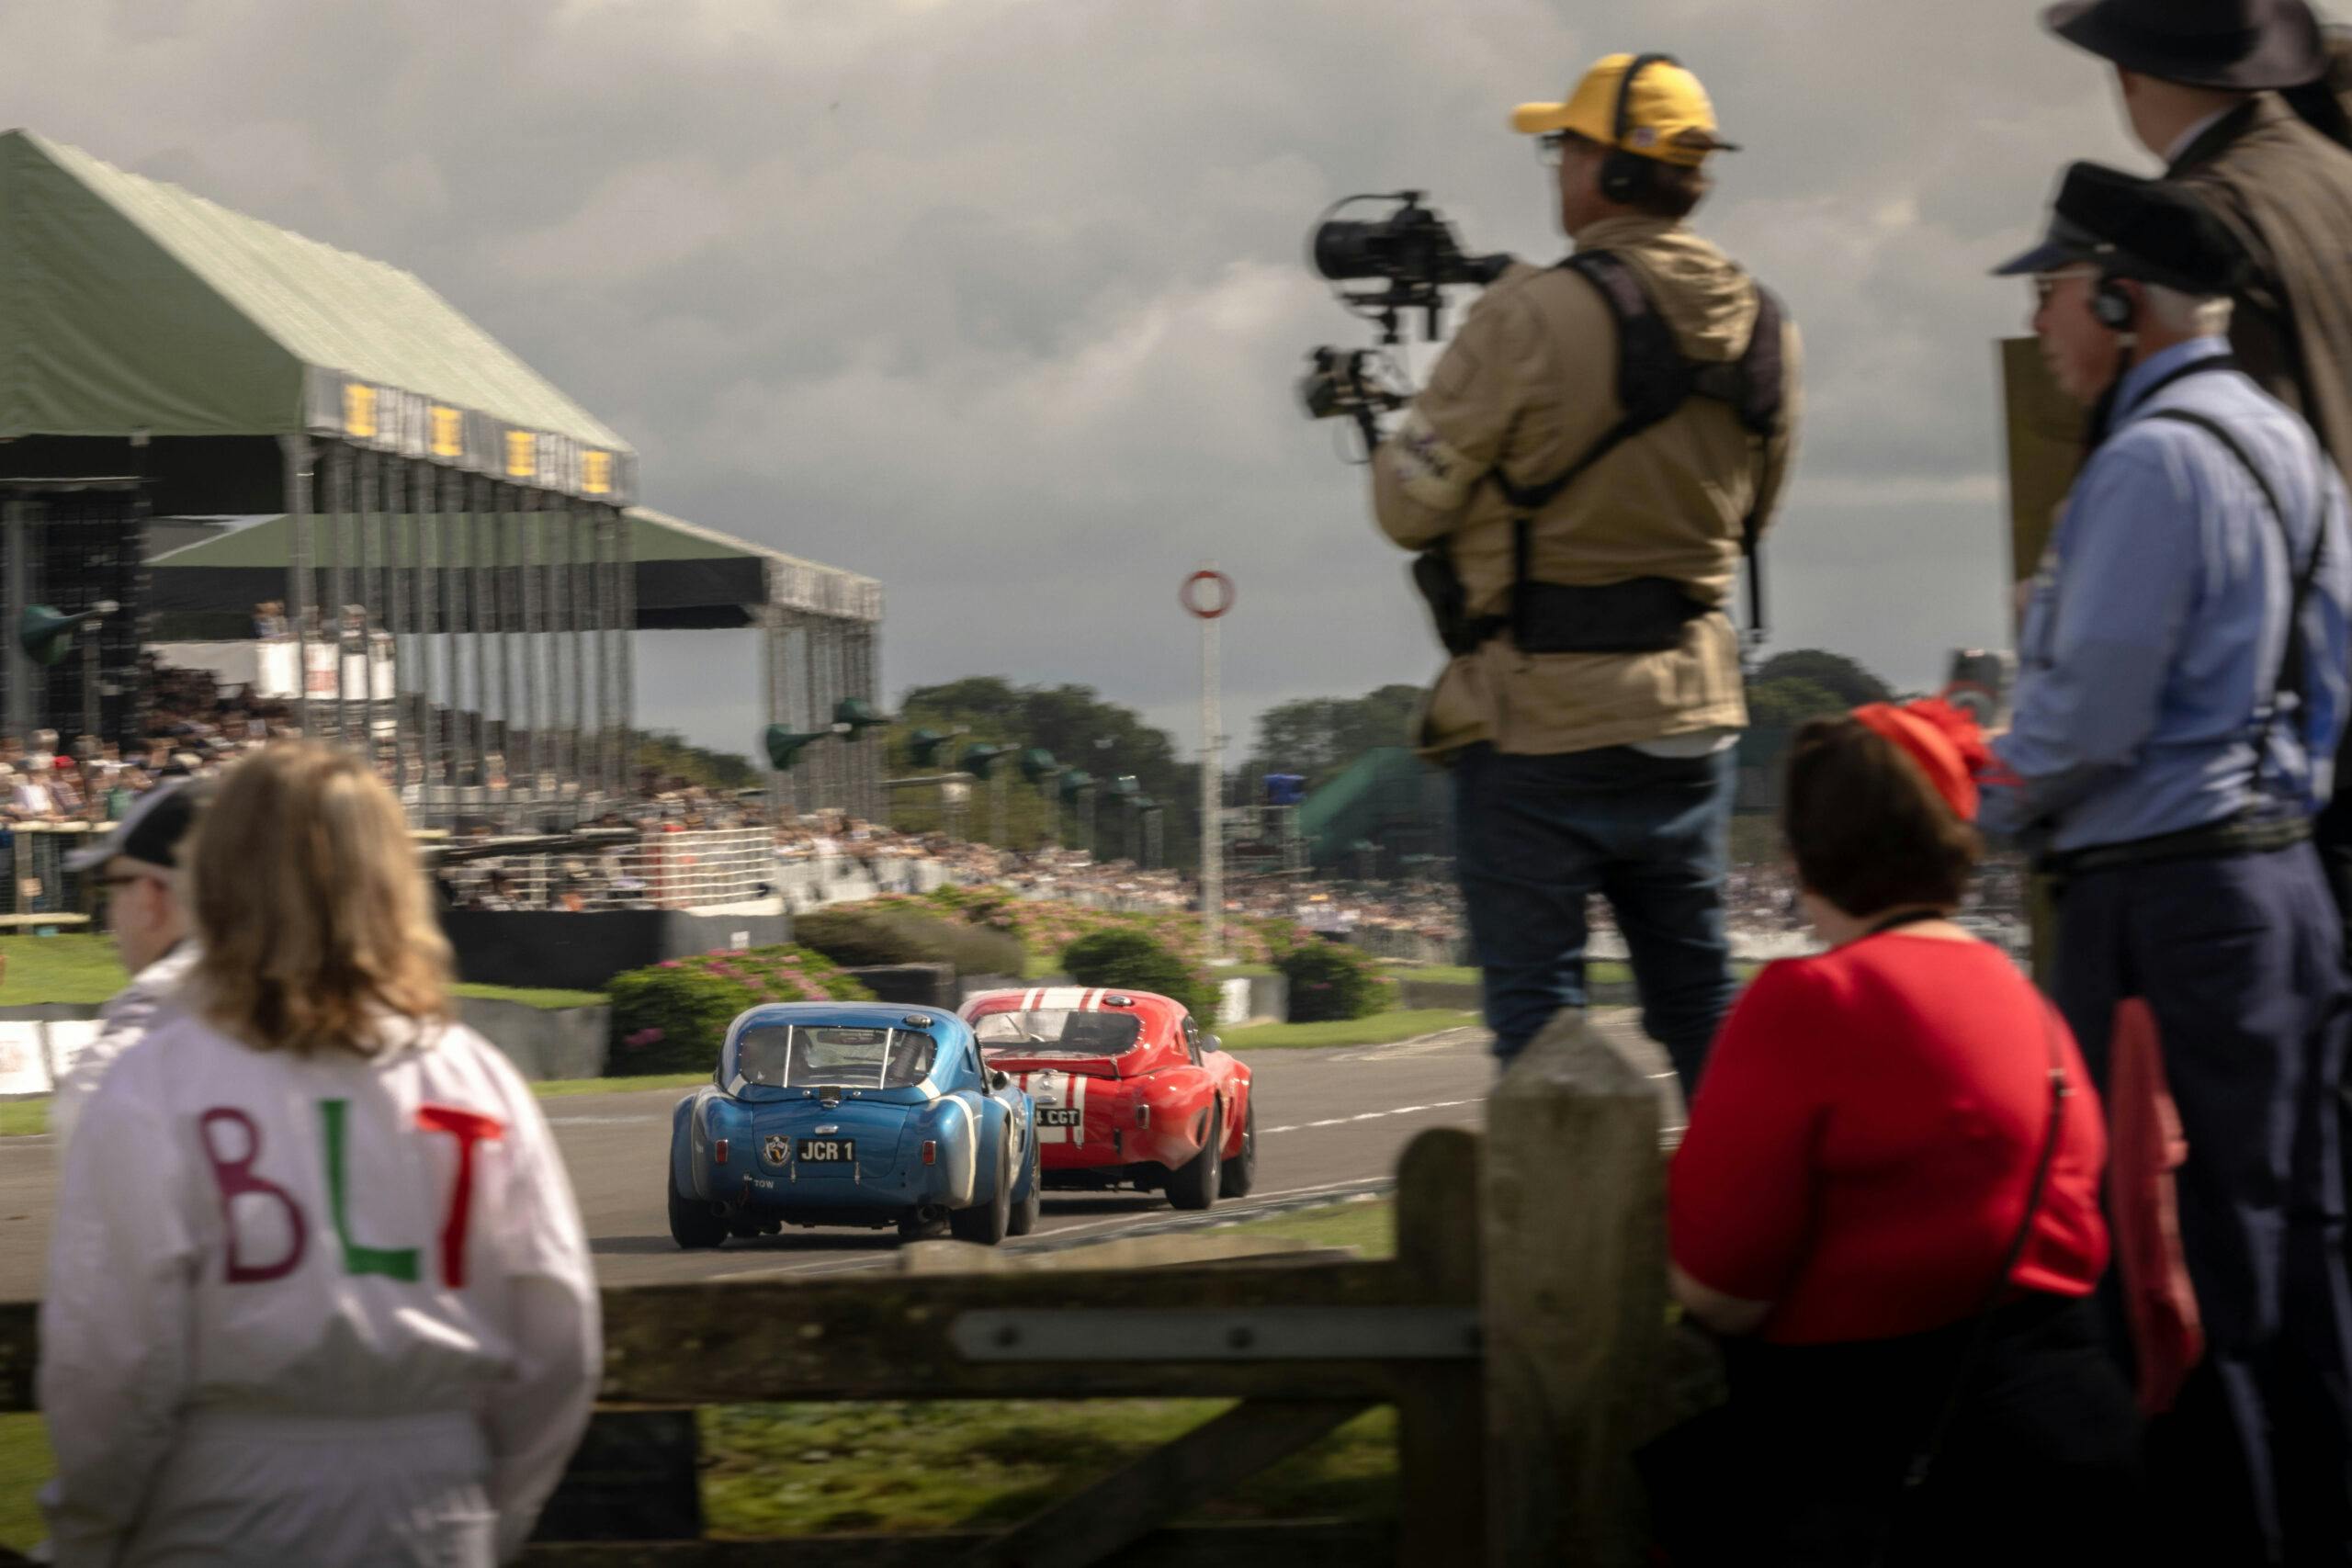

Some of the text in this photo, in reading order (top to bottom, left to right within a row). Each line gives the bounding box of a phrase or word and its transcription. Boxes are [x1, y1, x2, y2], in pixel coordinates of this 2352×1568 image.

[1047, 1110, 1078, 1124] CGT
[801, 1142, 853, 1160] JCR 1
[753, 1179, 774, 1189] TOW
[200, 1098, 504, 1289] BLT
